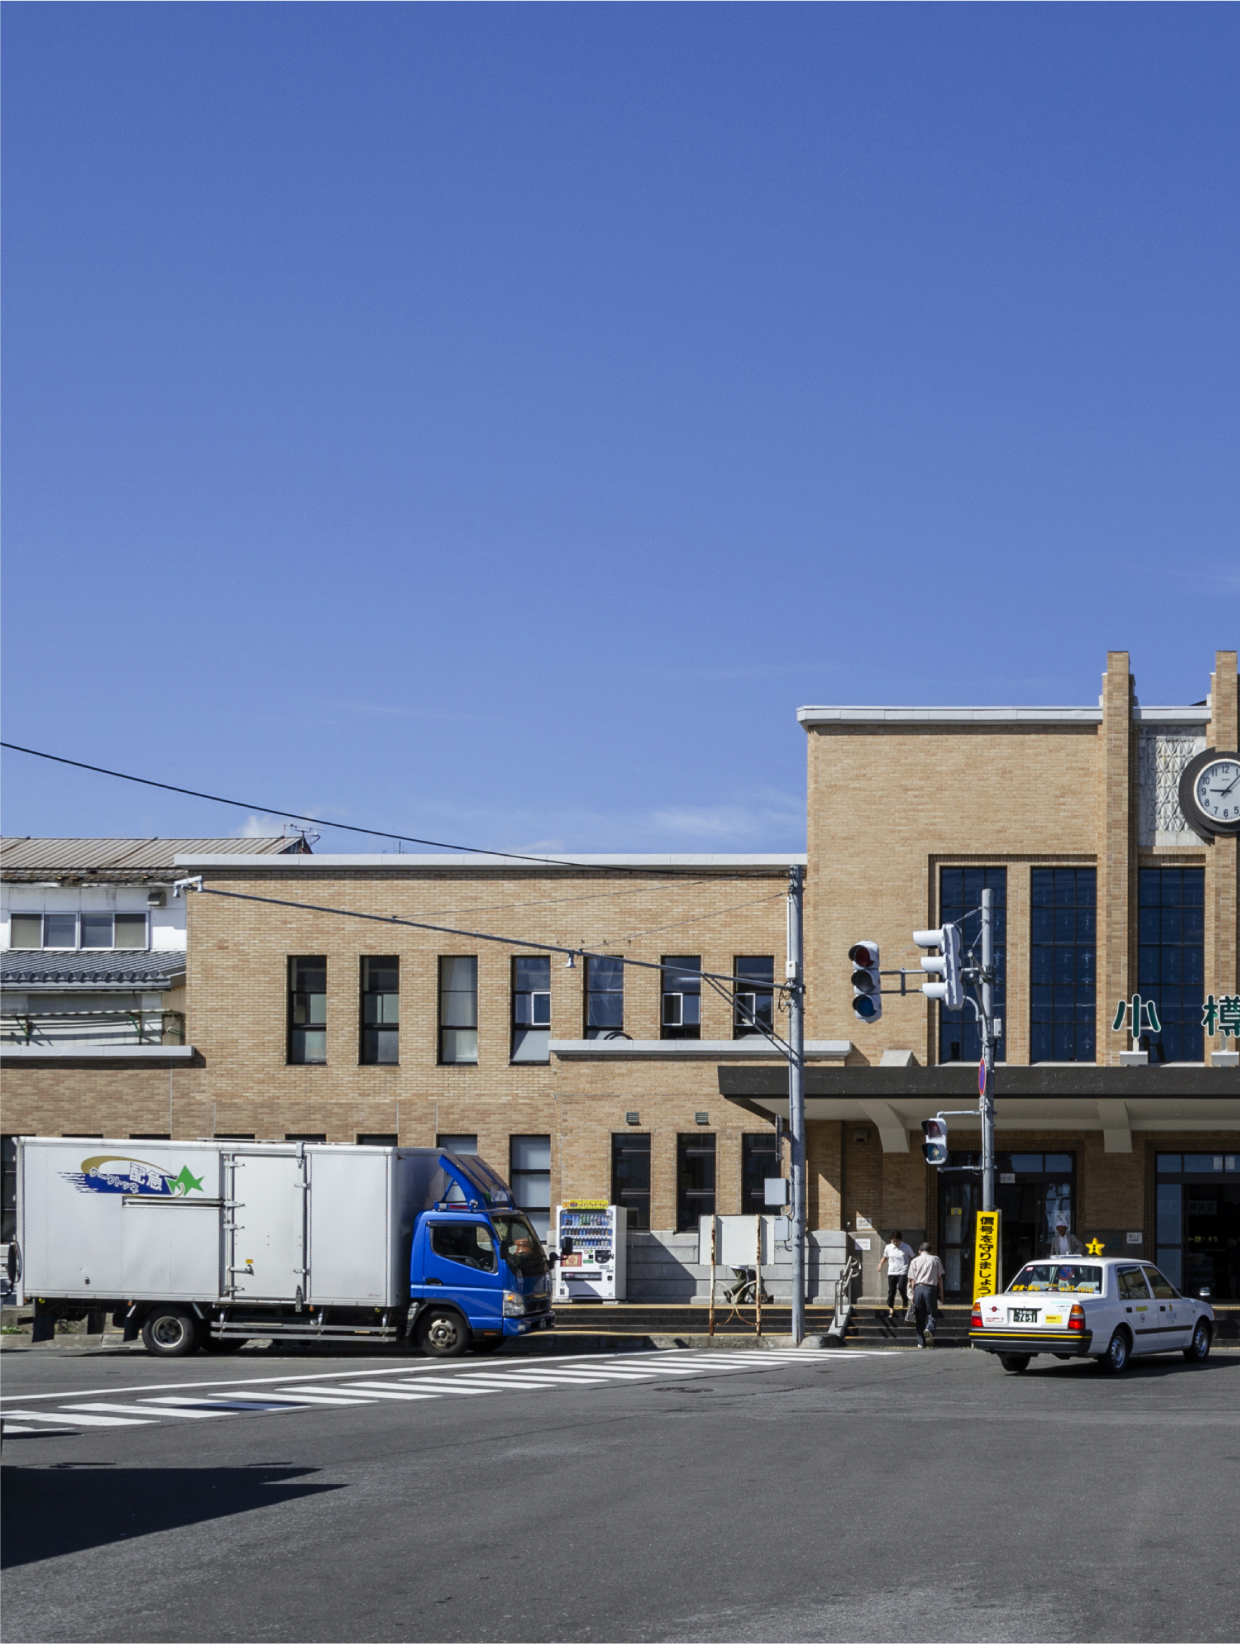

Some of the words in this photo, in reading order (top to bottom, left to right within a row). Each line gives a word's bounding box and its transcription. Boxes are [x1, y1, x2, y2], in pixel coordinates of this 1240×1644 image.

[1211, 768, 1218, 777] 11
[1221, 765, 1230, 774] 12
[1235, 768, 1239, 776] 1
[1202, 776, 1210, 785] 10
[1201, 787, 1207, 796] 9
[1204, 798, 1210, 807] 8
[1213, 806, 1219, 815] 7
[1223, 808, 1229, 818] 6
[1233, 805, 1240, 815] 5
[978, 1216, 994, 1295] 信号を守りましょう
